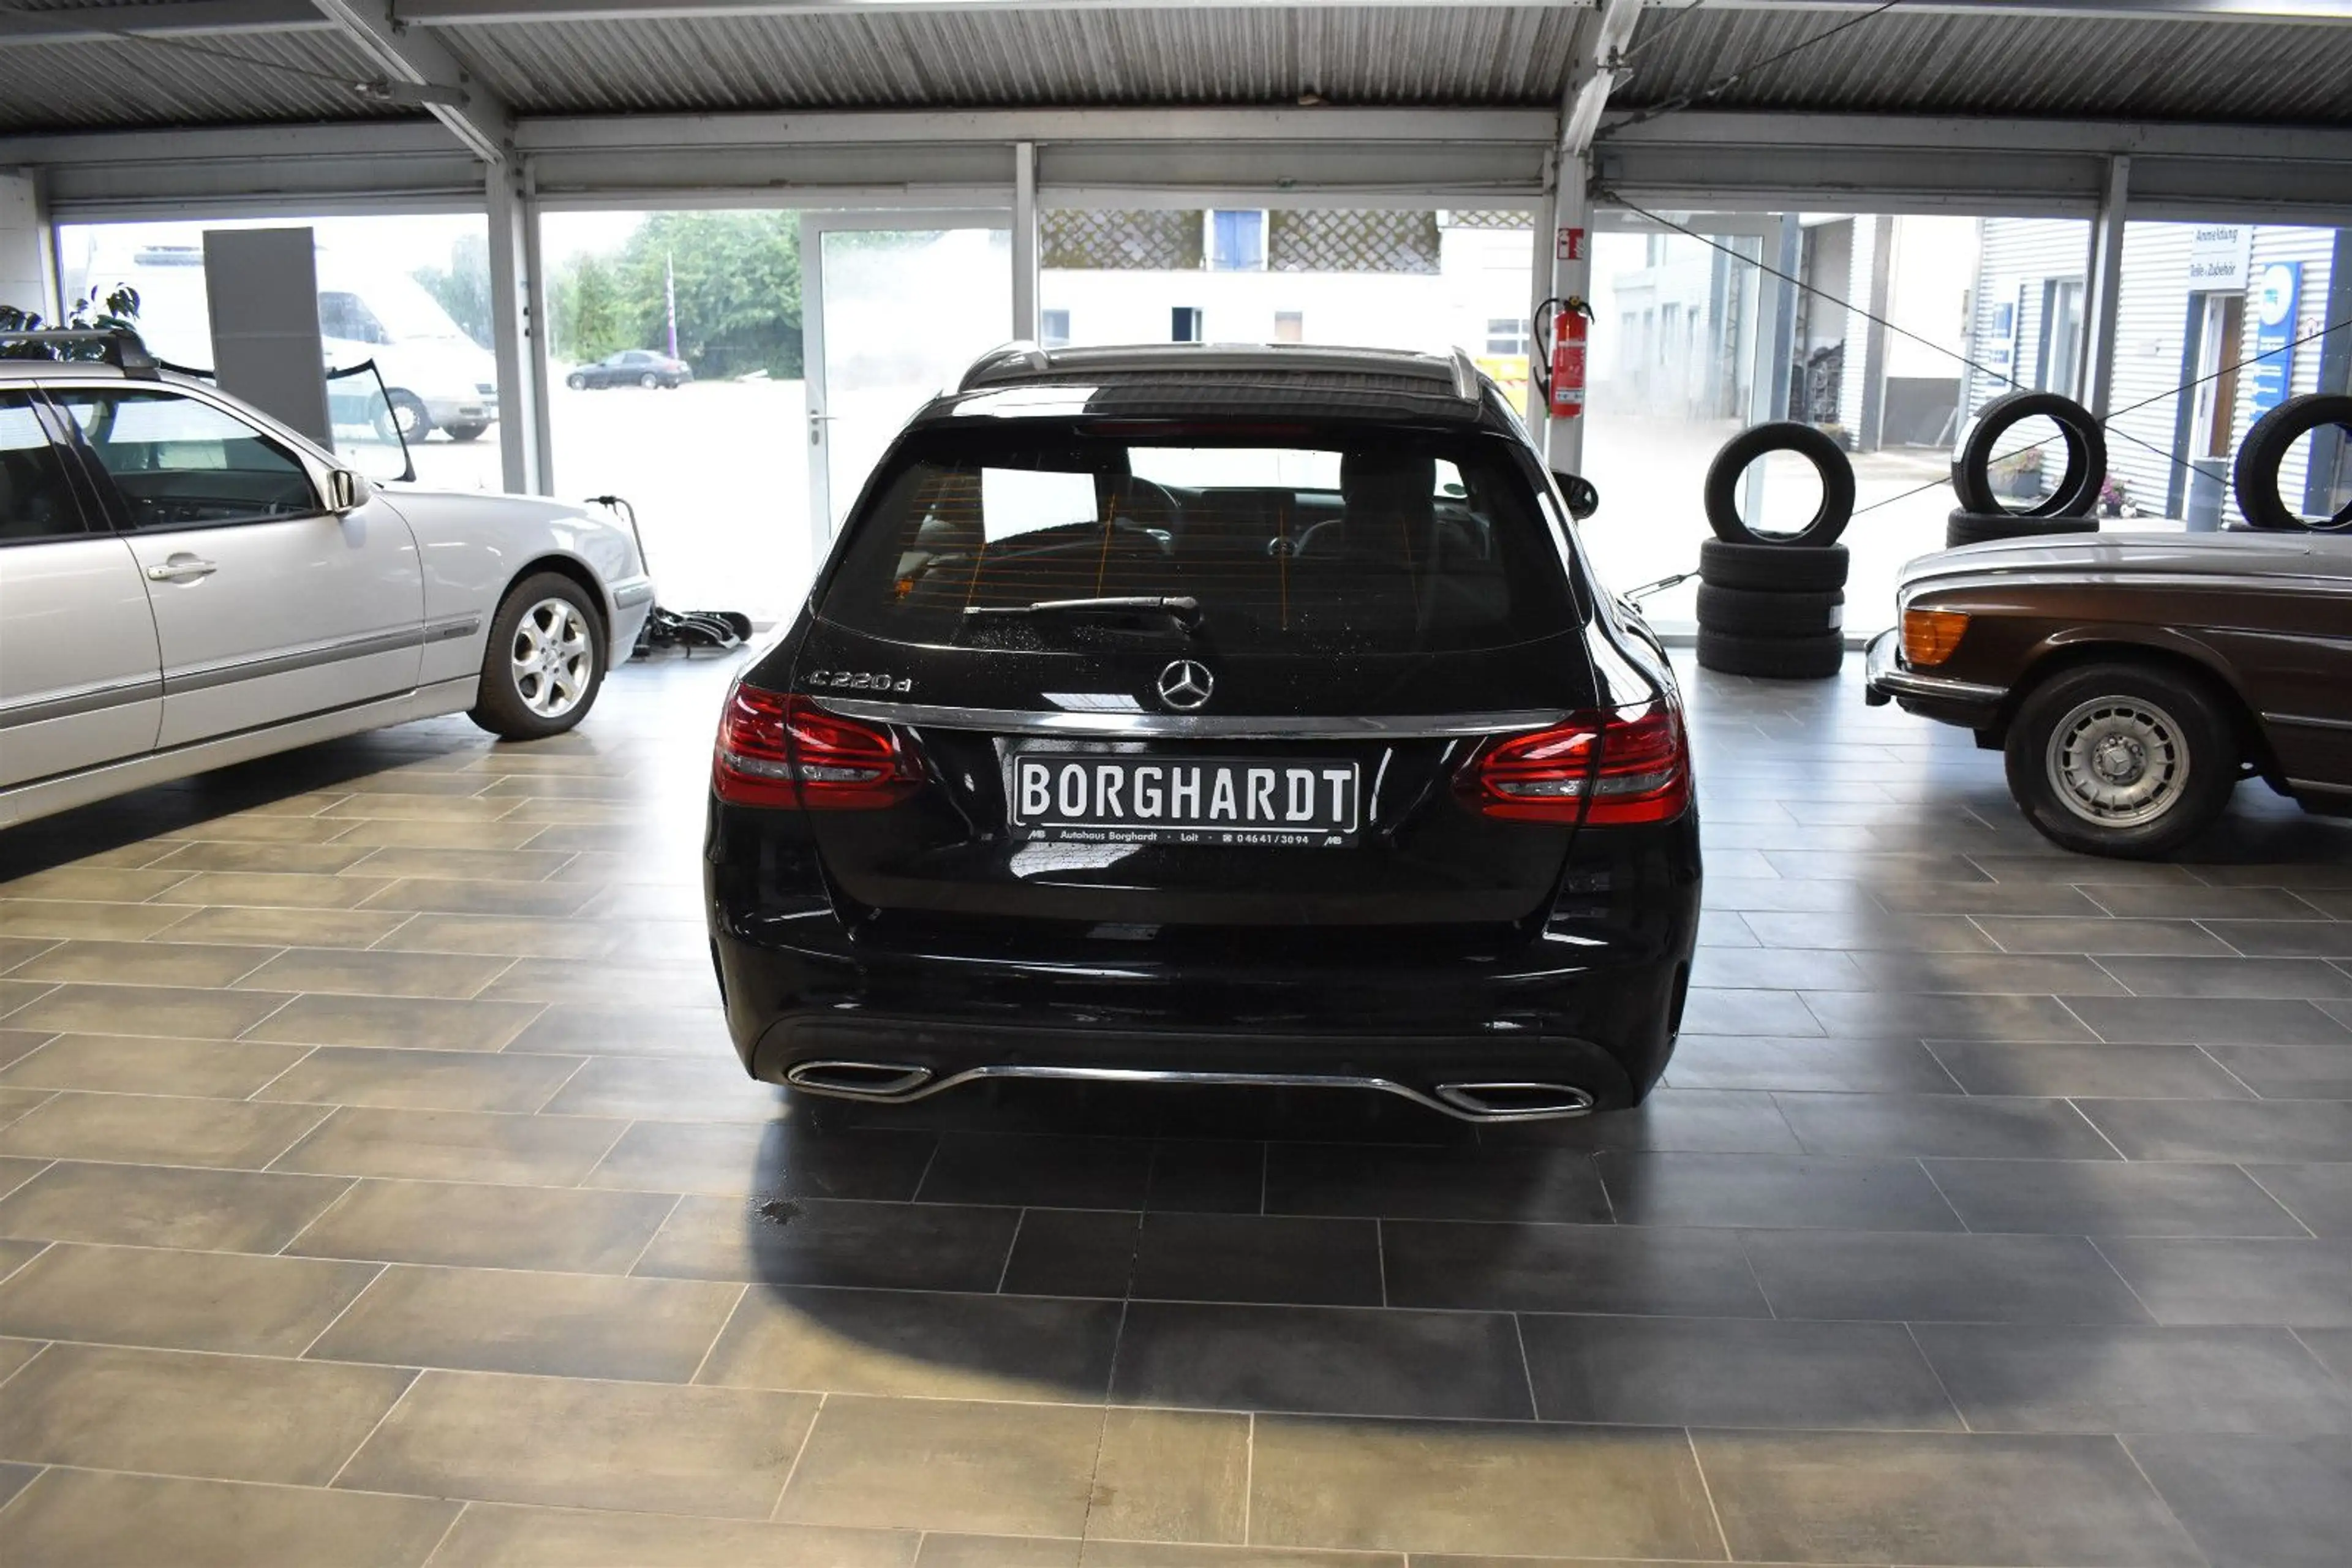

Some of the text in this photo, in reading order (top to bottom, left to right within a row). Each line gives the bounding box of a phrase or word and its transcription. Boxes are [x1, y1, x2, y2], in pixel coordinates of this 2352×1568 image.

[810, 671, 912, 692] C 220 d
[1022, 764, 1352, 822] BORGHARDT
[1060, 831, 1105, 840] Autohaus
[1109, 832, 1158, 841] Borghardt
[1181, 834, 1199, 842] Loit
